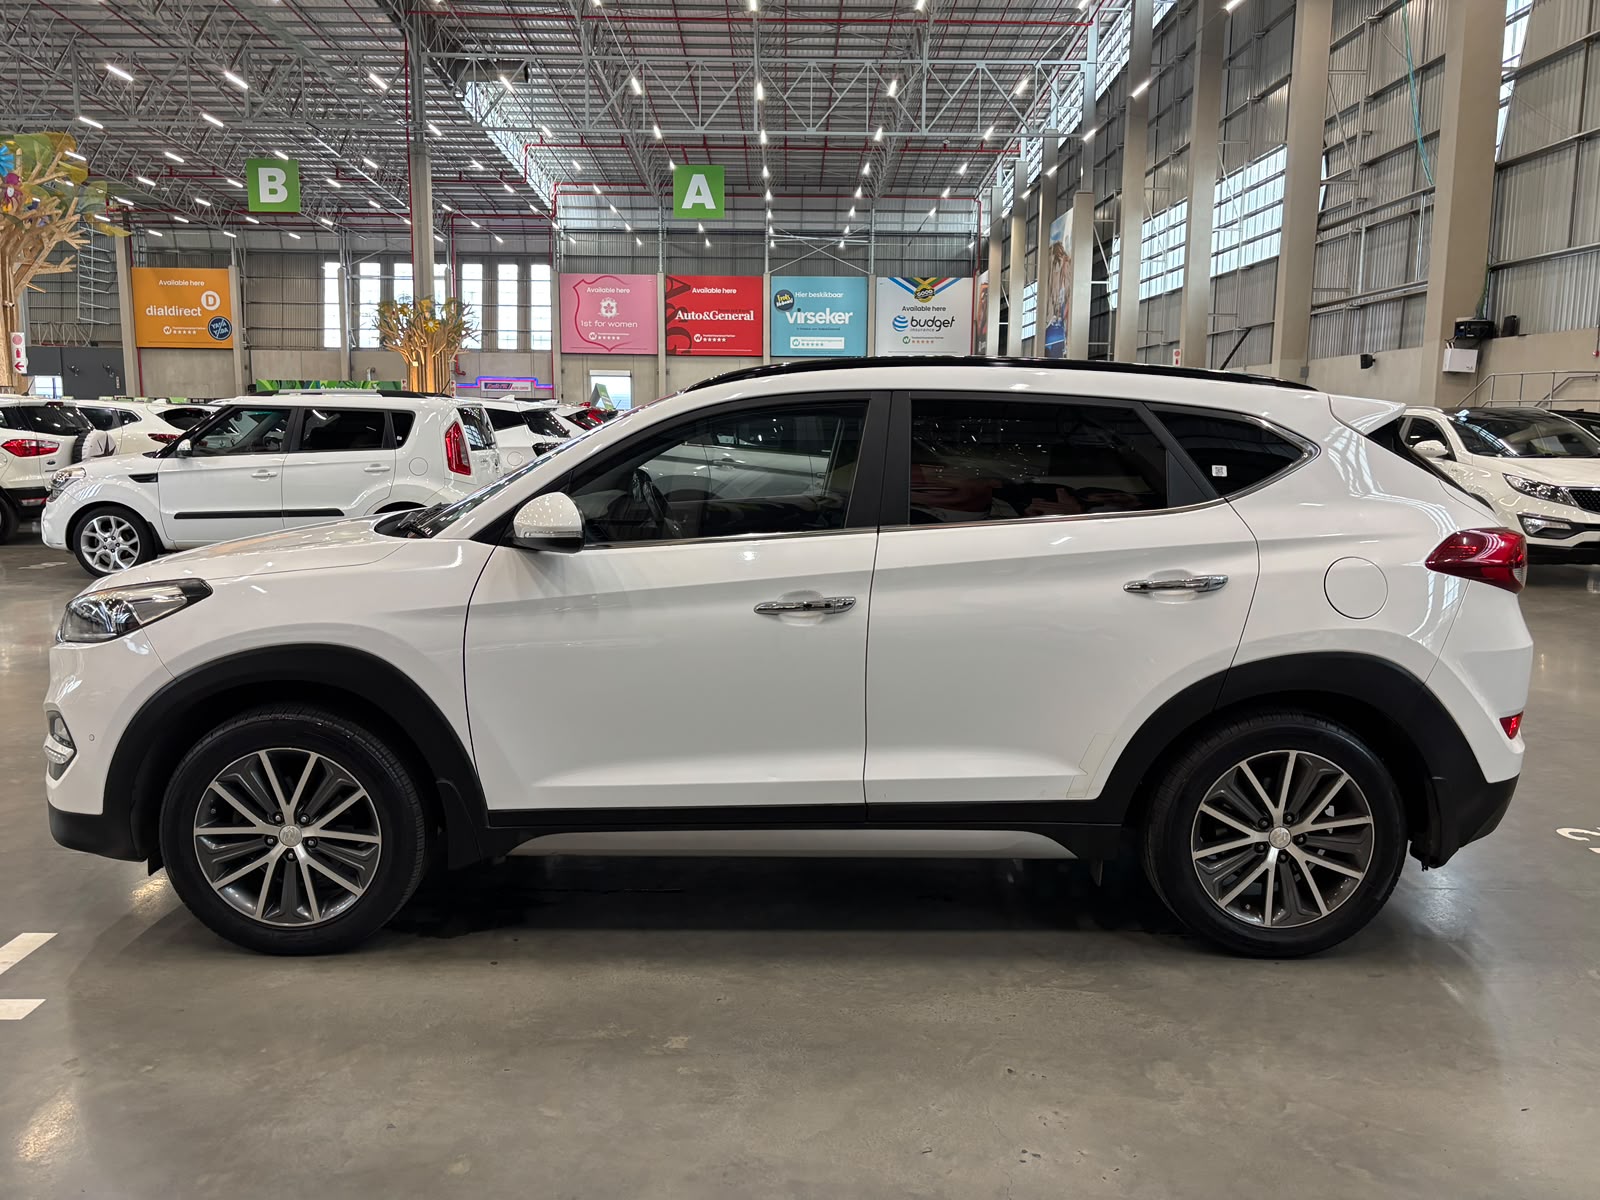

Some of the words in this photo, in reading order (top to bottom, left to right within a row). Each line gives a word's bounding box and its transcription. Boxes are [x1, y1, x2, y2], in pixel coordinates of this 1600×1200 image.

[258, 168, 288, 203] B
[682, 174, 716, 209] A
[146, 305, 202, 317] dialdirect
[675, 310, 754, 321] Auto&General
[785, 308, 853, 324] virseker
[911, 315, 955, 332] budget
